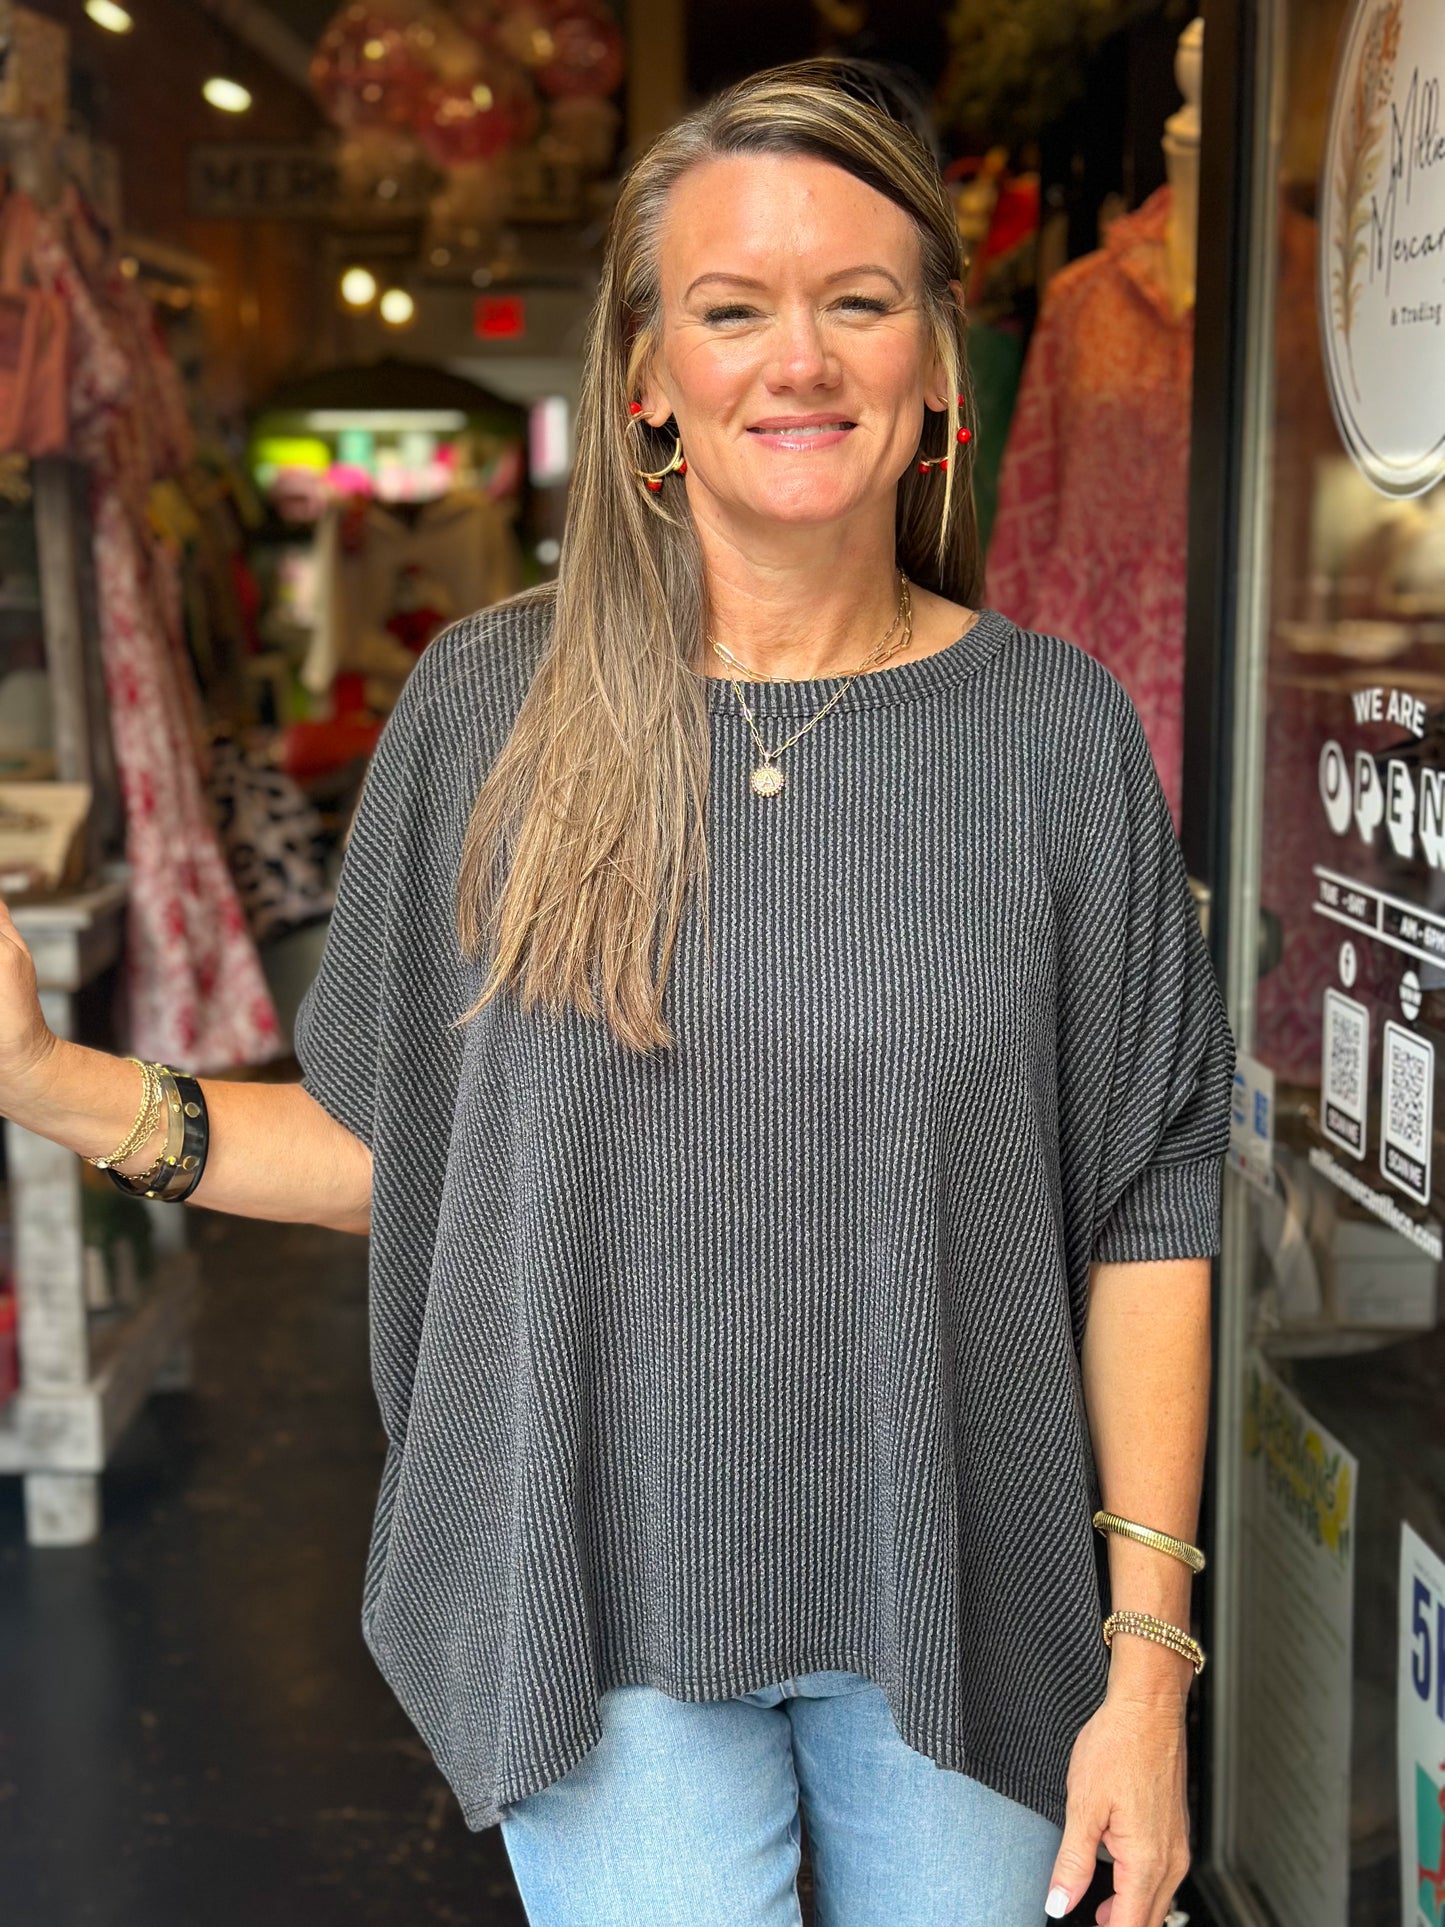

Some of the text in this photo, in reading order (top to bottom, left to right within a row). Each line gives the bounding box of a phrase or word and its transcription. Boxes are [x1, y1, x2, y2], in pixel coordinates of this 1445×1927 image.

[1353, 688, 1427, 738] WE ARE
[1318, 739, 1445, 867] OPEN
